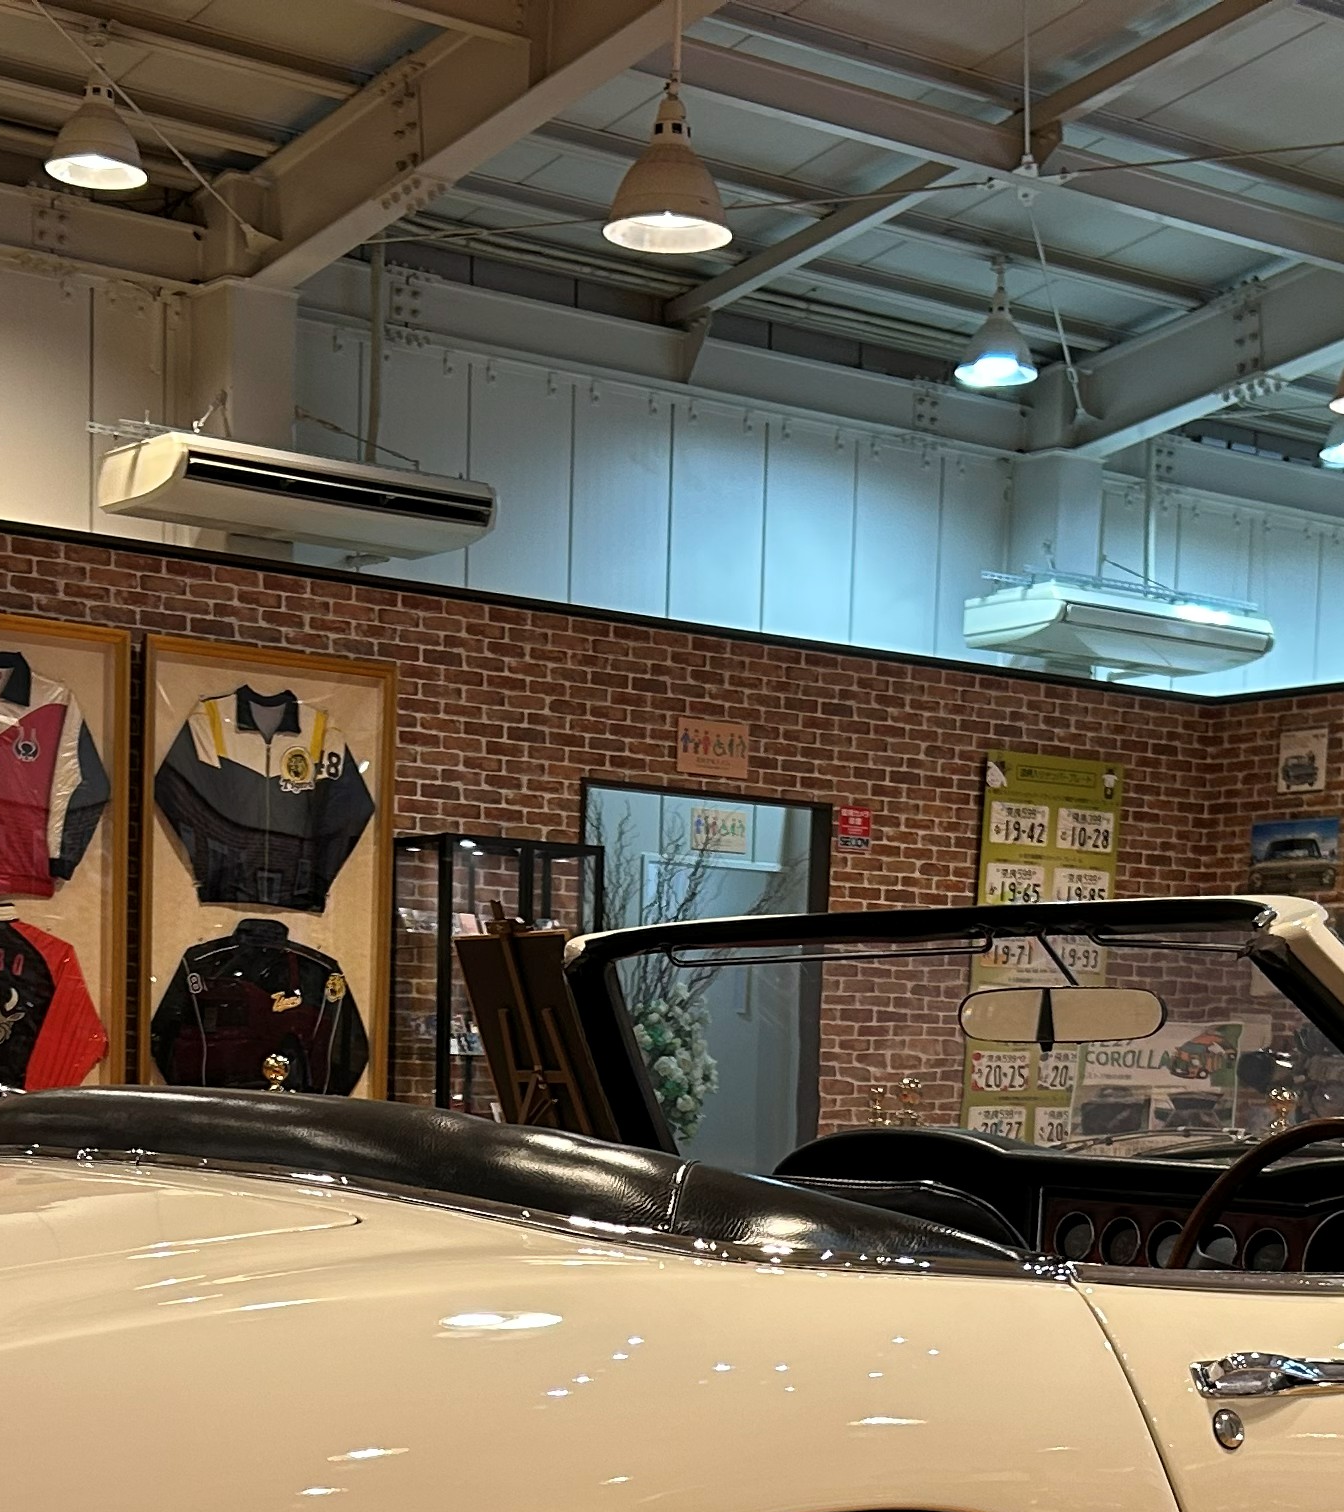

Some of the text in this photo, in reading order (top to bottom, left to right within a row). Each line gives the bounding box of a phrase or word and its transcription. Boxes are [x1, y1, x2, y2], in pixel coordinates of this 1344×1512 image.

[1005, 820, 1045, 844] 19-42
[1070, 826, 1110, 849] 10-28
[1000, 881, 1040, 903] 19-65
[993, 944, 1032, 965] 19-71
[1061, 946, 1099, 969] 19-93
[1085, 1049, 1170, 1069] COROLLA
[984, 1065, 1026, 1088] 20-25
